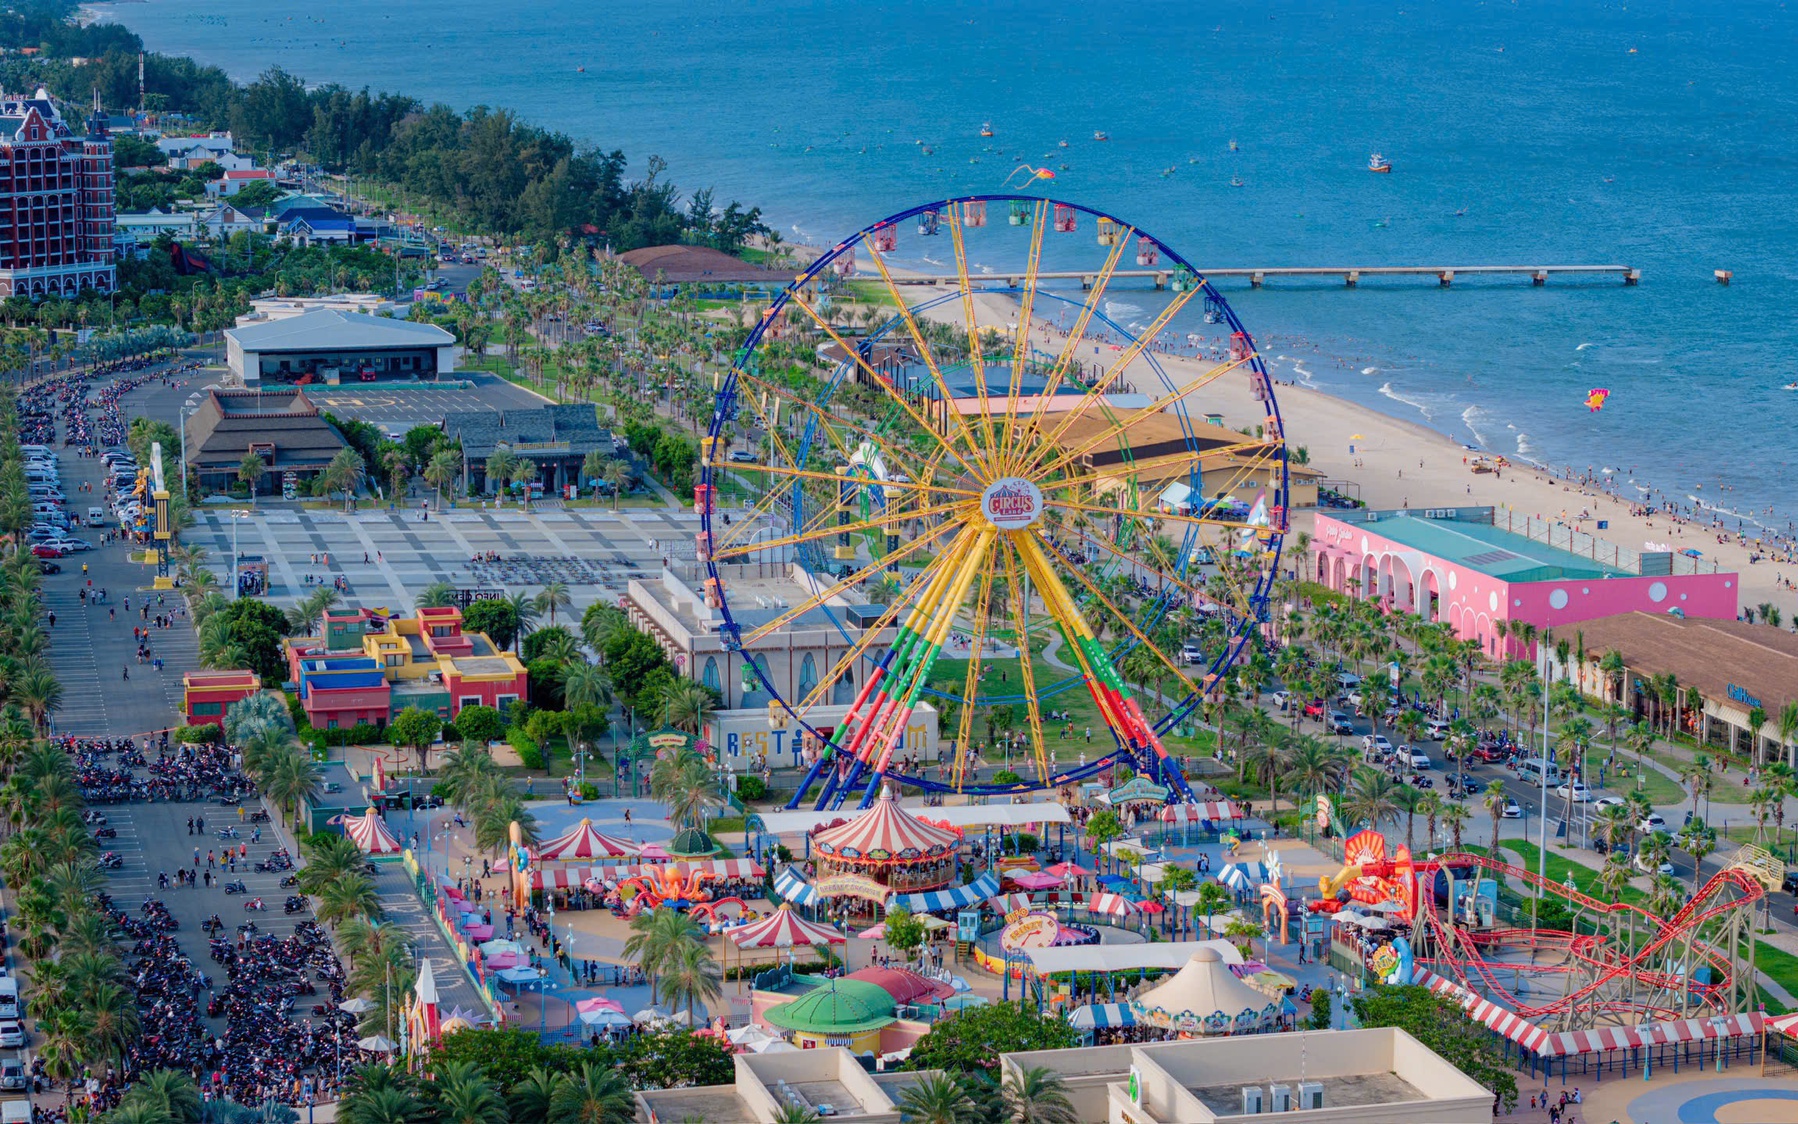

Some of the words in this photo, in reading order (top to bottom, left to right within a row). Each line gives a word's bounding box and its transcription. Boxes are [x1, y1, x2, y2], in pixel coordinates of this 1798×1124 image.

[989, 495, 1035, 515] CIRCUS
[727, 730, 787, 757] REST
[1005, 907, 1028, 924] UFO
[1010, 920, 1042, 941] FRENZY
